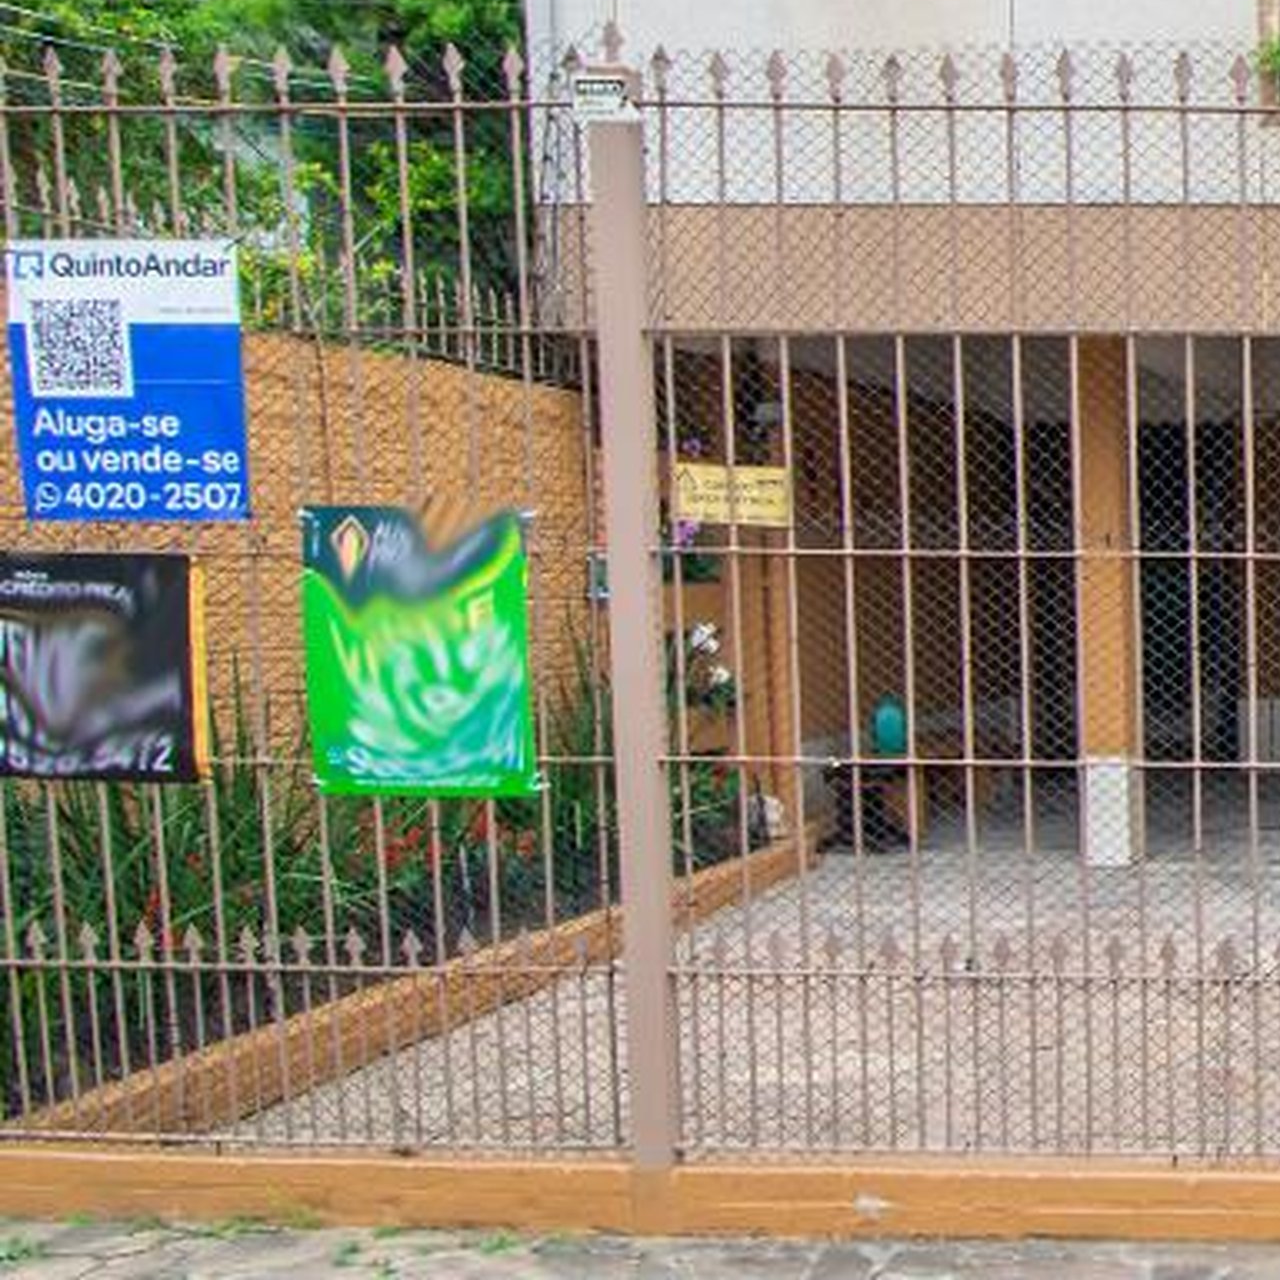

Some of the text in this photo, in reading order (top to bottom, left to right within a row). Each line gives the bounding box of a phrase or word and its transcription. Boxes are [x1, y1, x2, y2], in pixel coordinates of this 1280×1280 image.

[50, 252, 230, 278] QuintoAndar
[33, 407, 181, 444] Aluga-se
[36, 444, 240, 474] ou vende-se
[64, 482, 242, 510] 4020-2507
